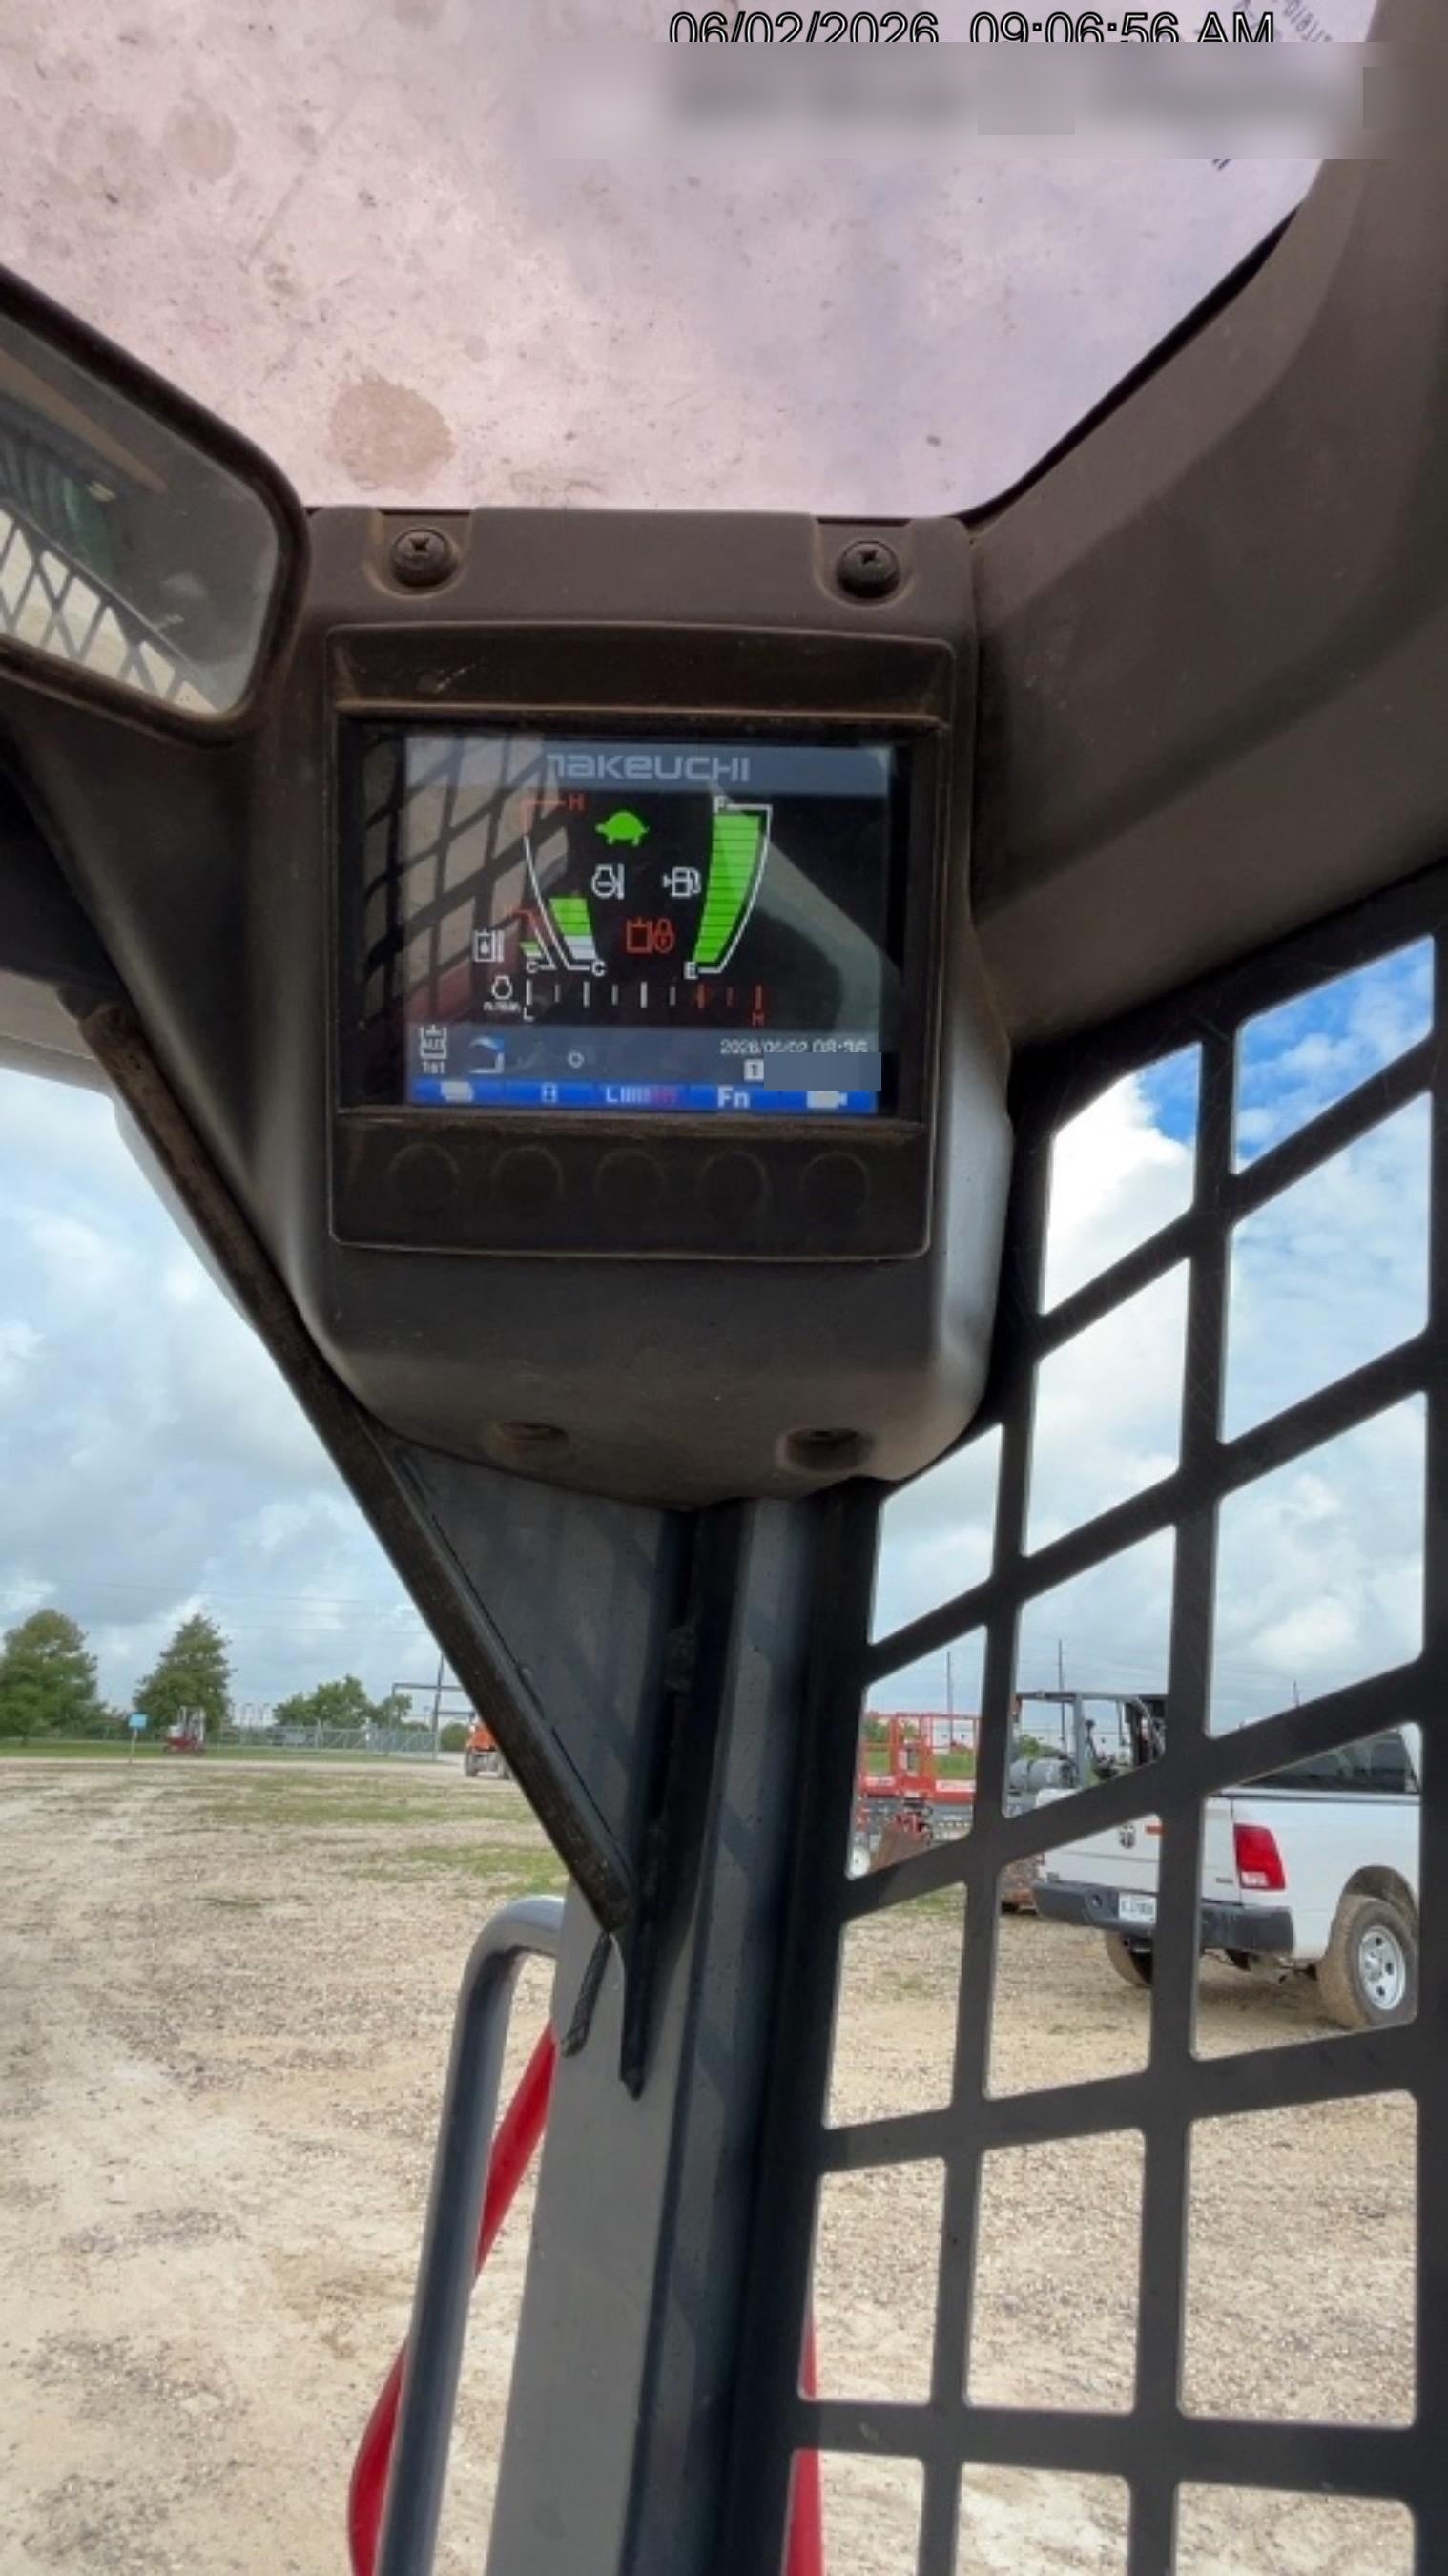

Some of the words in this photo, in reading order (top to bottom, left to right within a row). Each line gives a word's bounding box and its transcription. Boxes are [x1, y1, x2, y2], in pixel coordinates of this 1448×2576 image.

[569, 793, 585, 810] H
[591, 960, 607, 977] C
[717, 1085, 751, 1109] Fn
